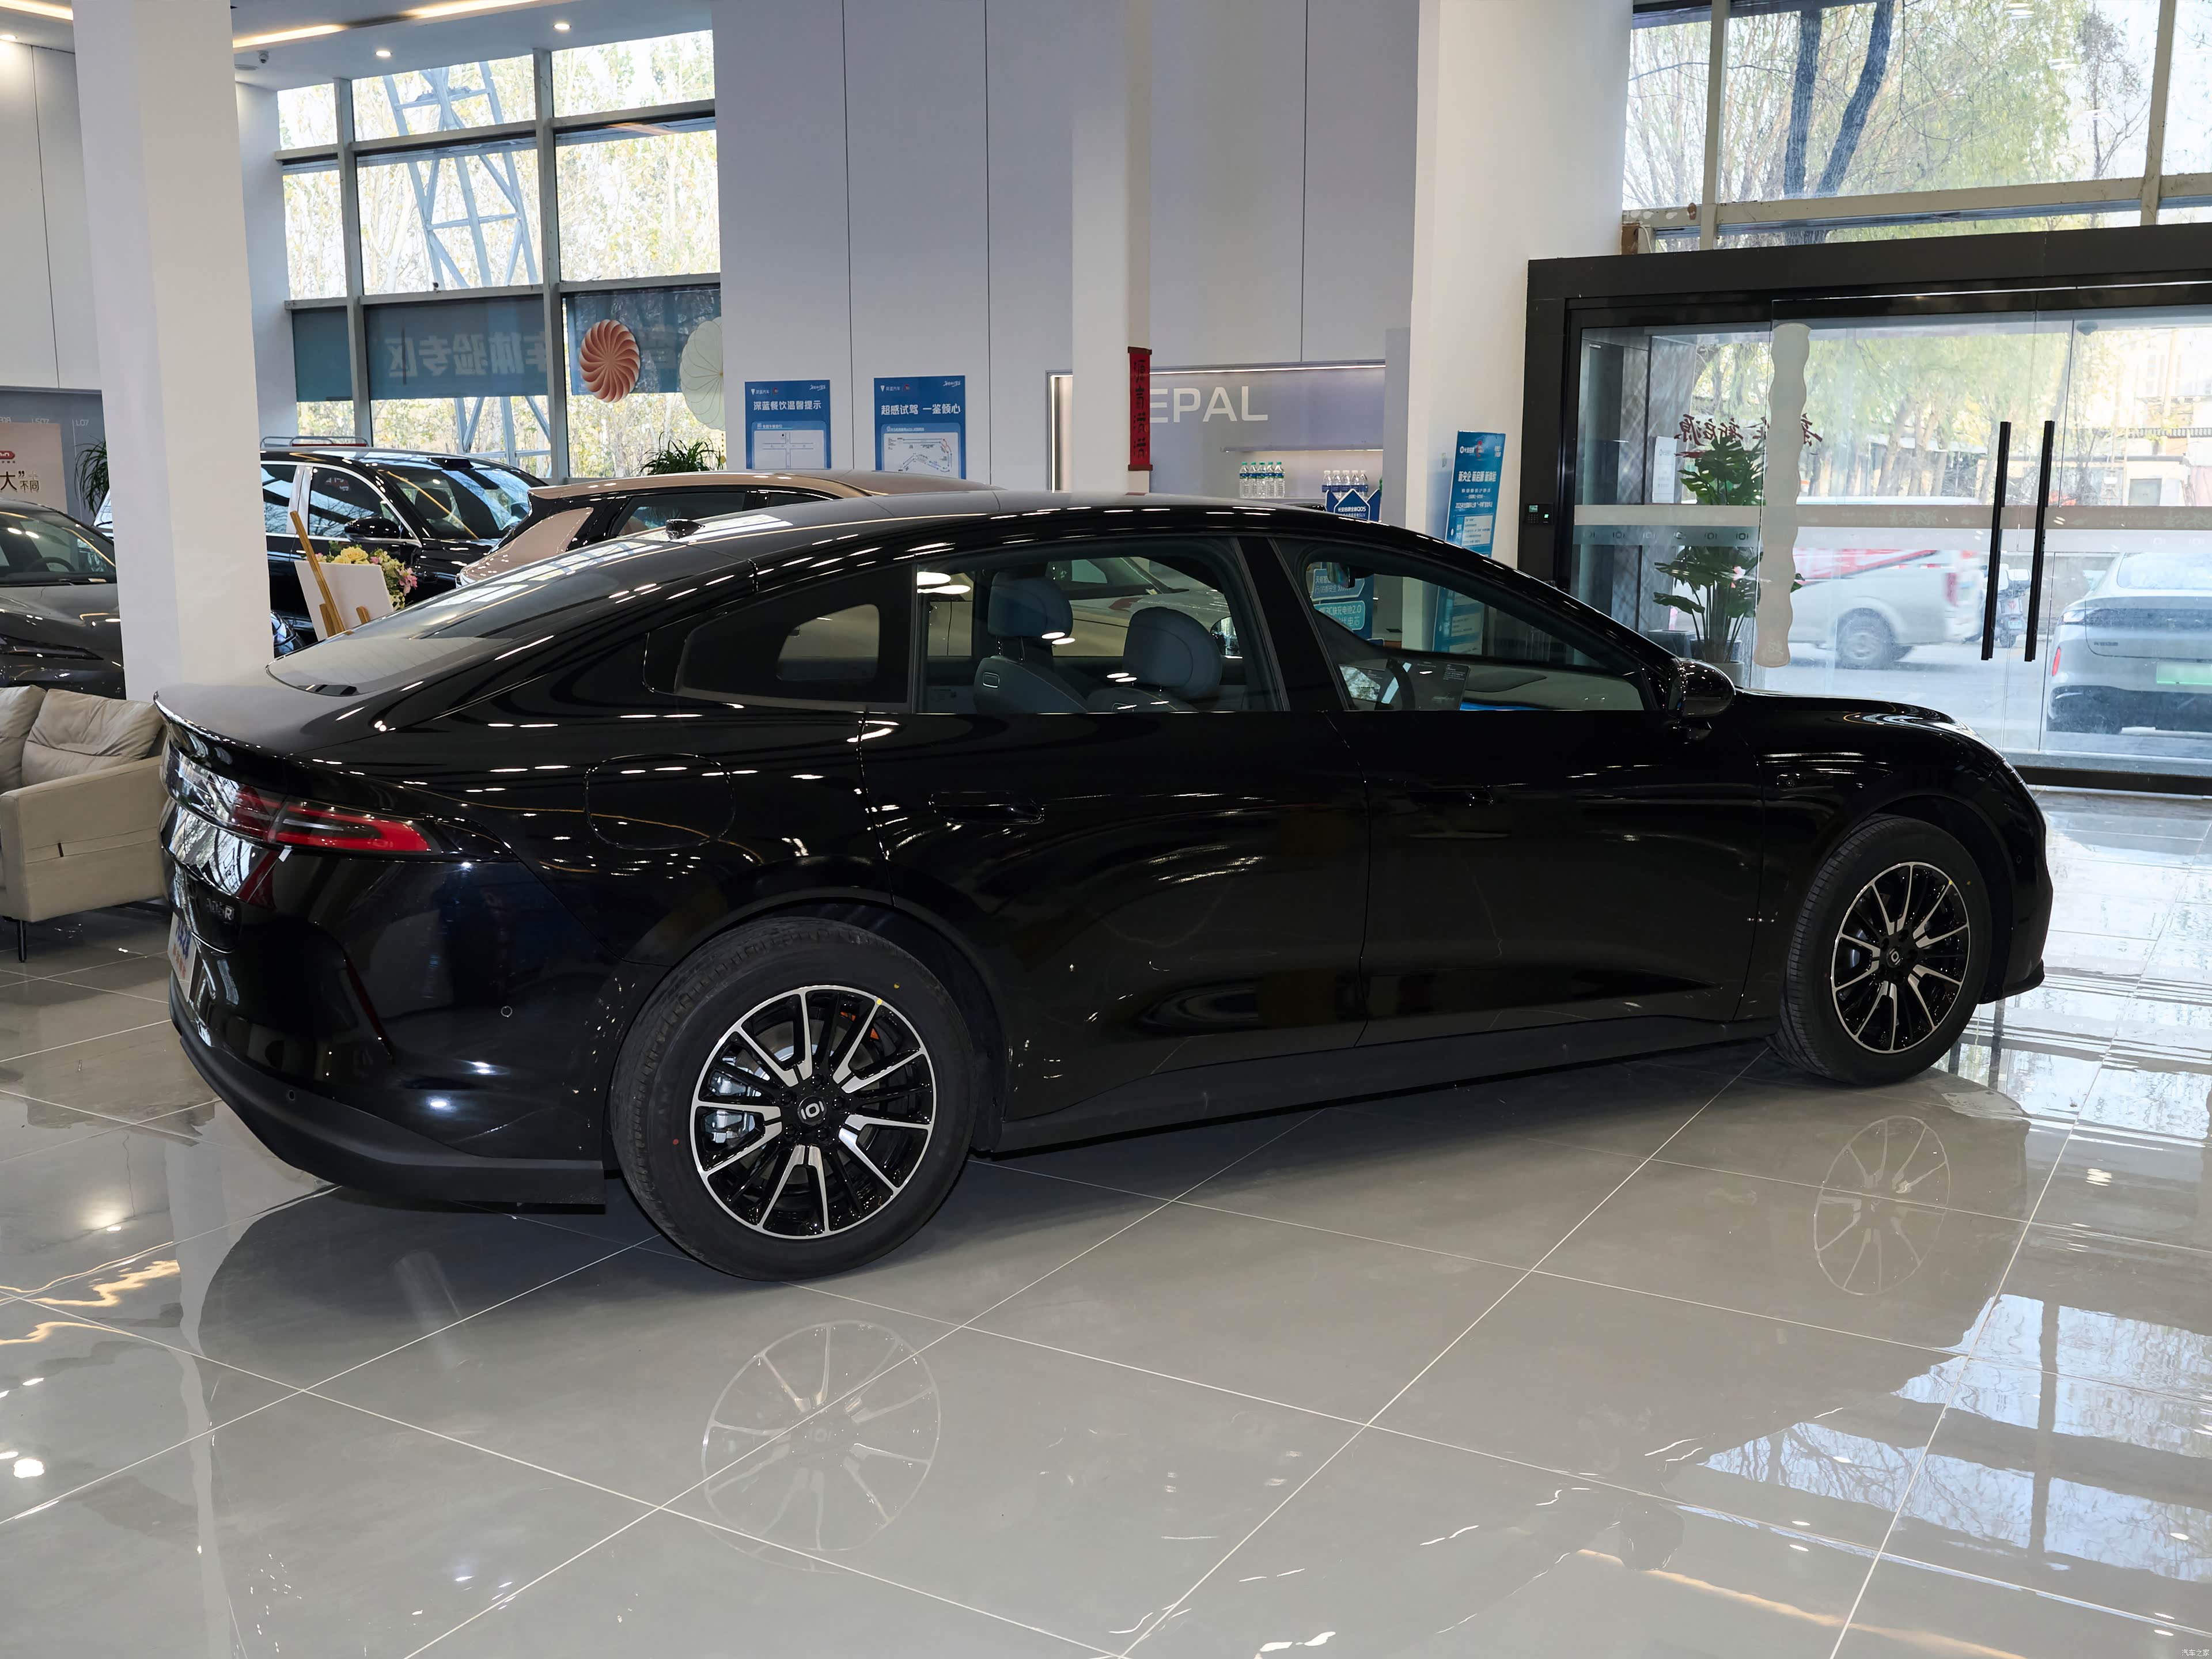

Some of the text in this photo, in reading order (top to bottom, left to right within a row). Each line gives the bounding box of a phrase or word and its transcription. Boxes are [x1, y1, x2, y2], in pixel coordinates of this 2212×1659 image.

[753, 400, 821, 411] 深蓝餐饮温馨提示
[881, 403, 961, 415] 超感试驾 一鉴倾心
